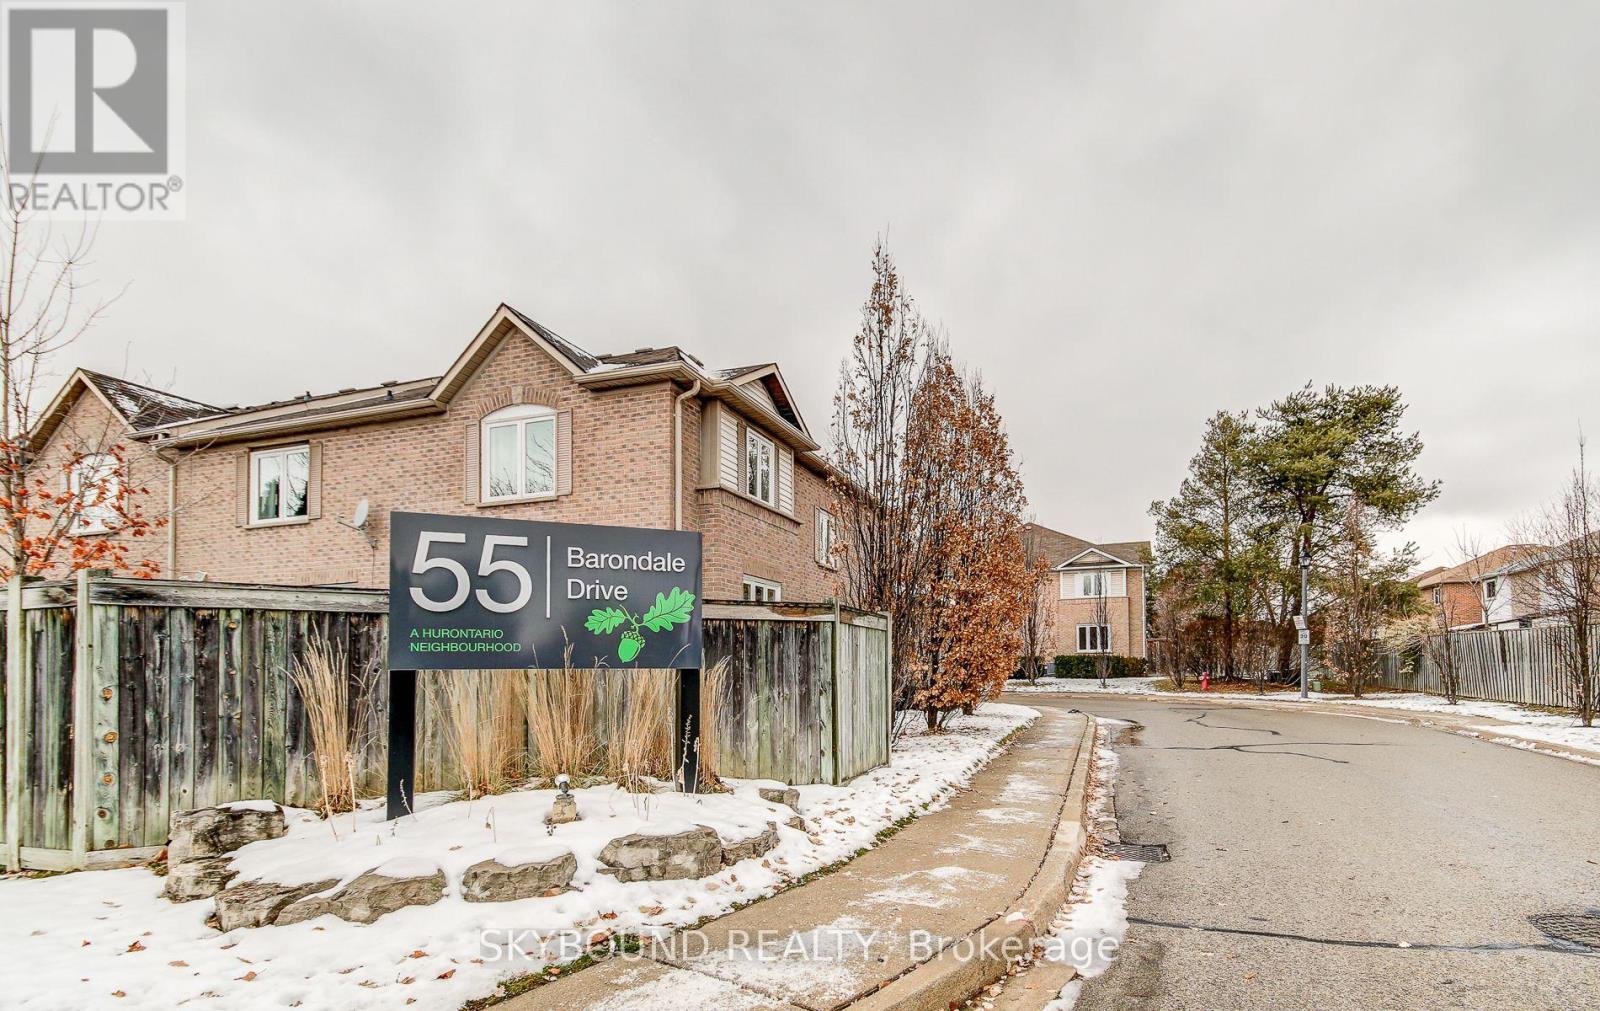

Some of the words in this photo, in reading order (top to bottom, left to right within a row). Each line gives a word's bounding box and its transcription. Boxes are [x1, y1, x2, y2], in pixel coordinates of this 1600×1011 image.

[567, 547, 686, 572] Barondale
[409, 531, 533, 614] 55
[567, 578, 628, 600] Drive
[409, 629, 419, 639] A
[422, 629, 504, 640] HURONTARIO
[410, 642, 521, 653] NEIGHBOURHOOD
